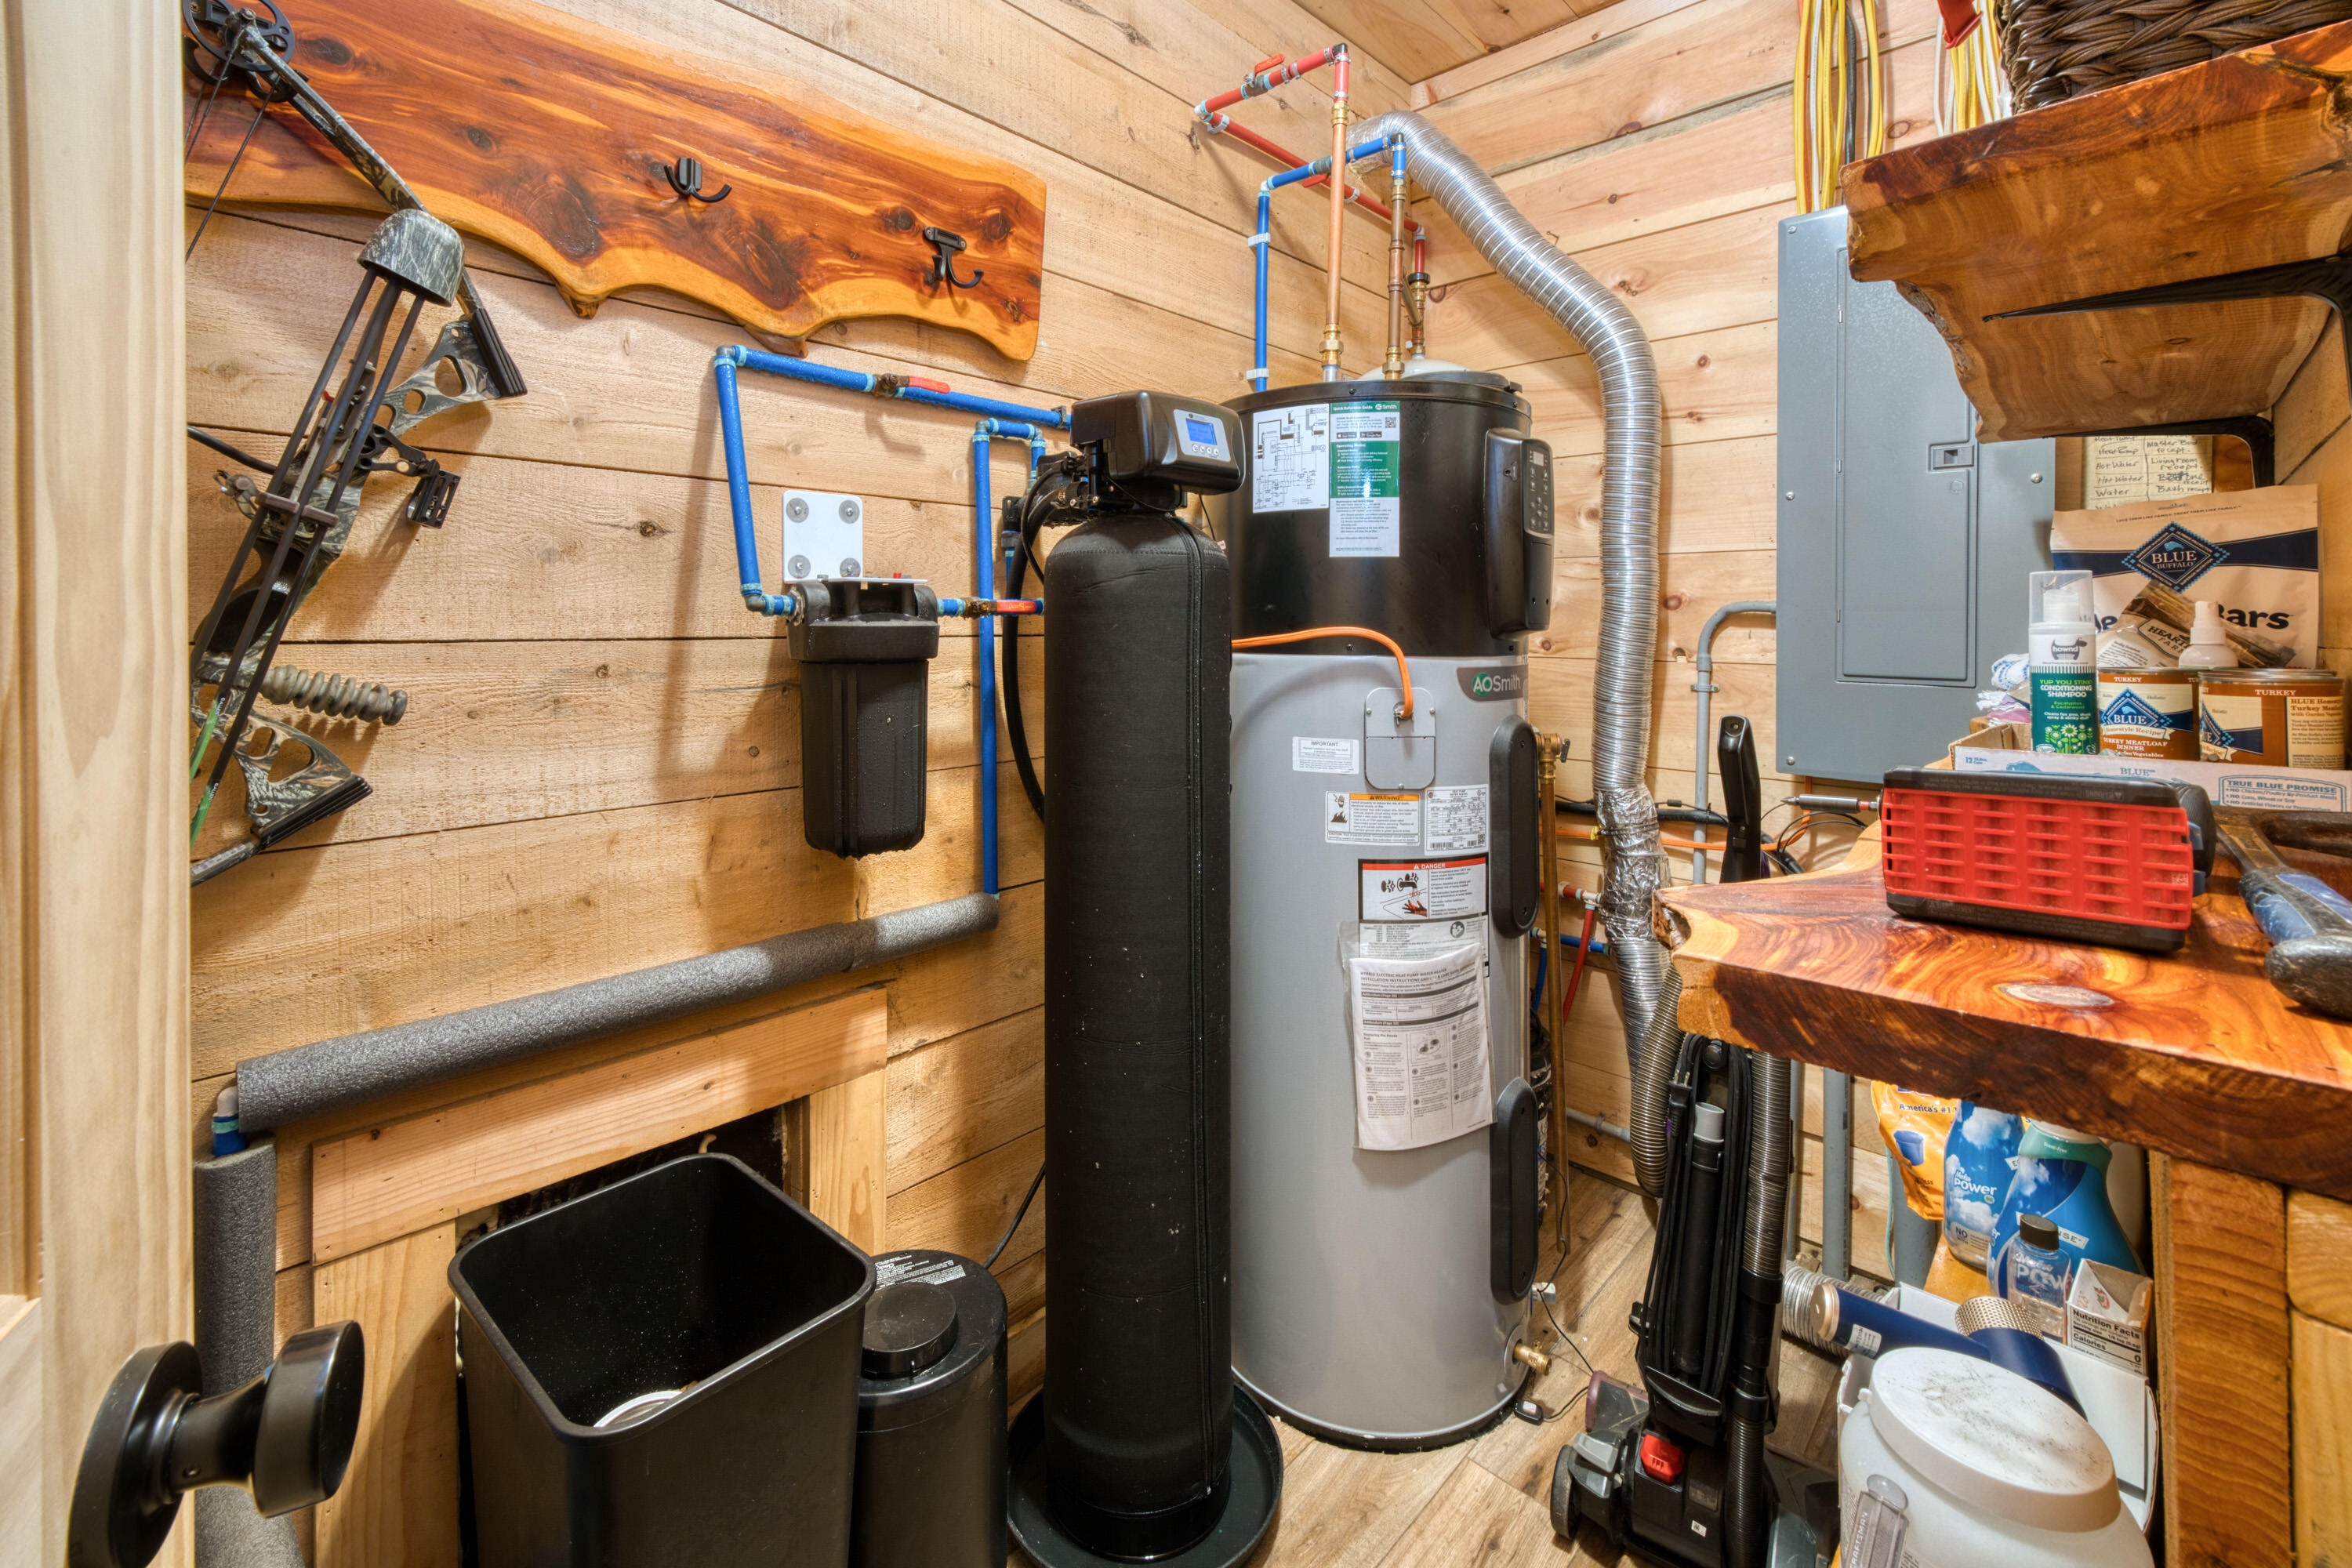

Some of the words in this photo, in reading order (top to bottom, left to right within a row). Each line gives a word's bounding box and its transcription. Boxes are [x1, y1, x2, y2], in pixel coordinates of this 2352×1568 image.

[2151, 550, 2198, 564] BLUE
[2114, 714, 2147, 724] BLUE
[2287, 785, 2337, 793] PROMISE
[1899, 1104, 1938, 1112] America's
[1955, 1226, 1968, 1238] NO
[2073, 1309, 2111, 1329] Nutrition
[2114, 1324, 2140, 1339] Facts
[2073, 1334, 2106, 1350] Calories
